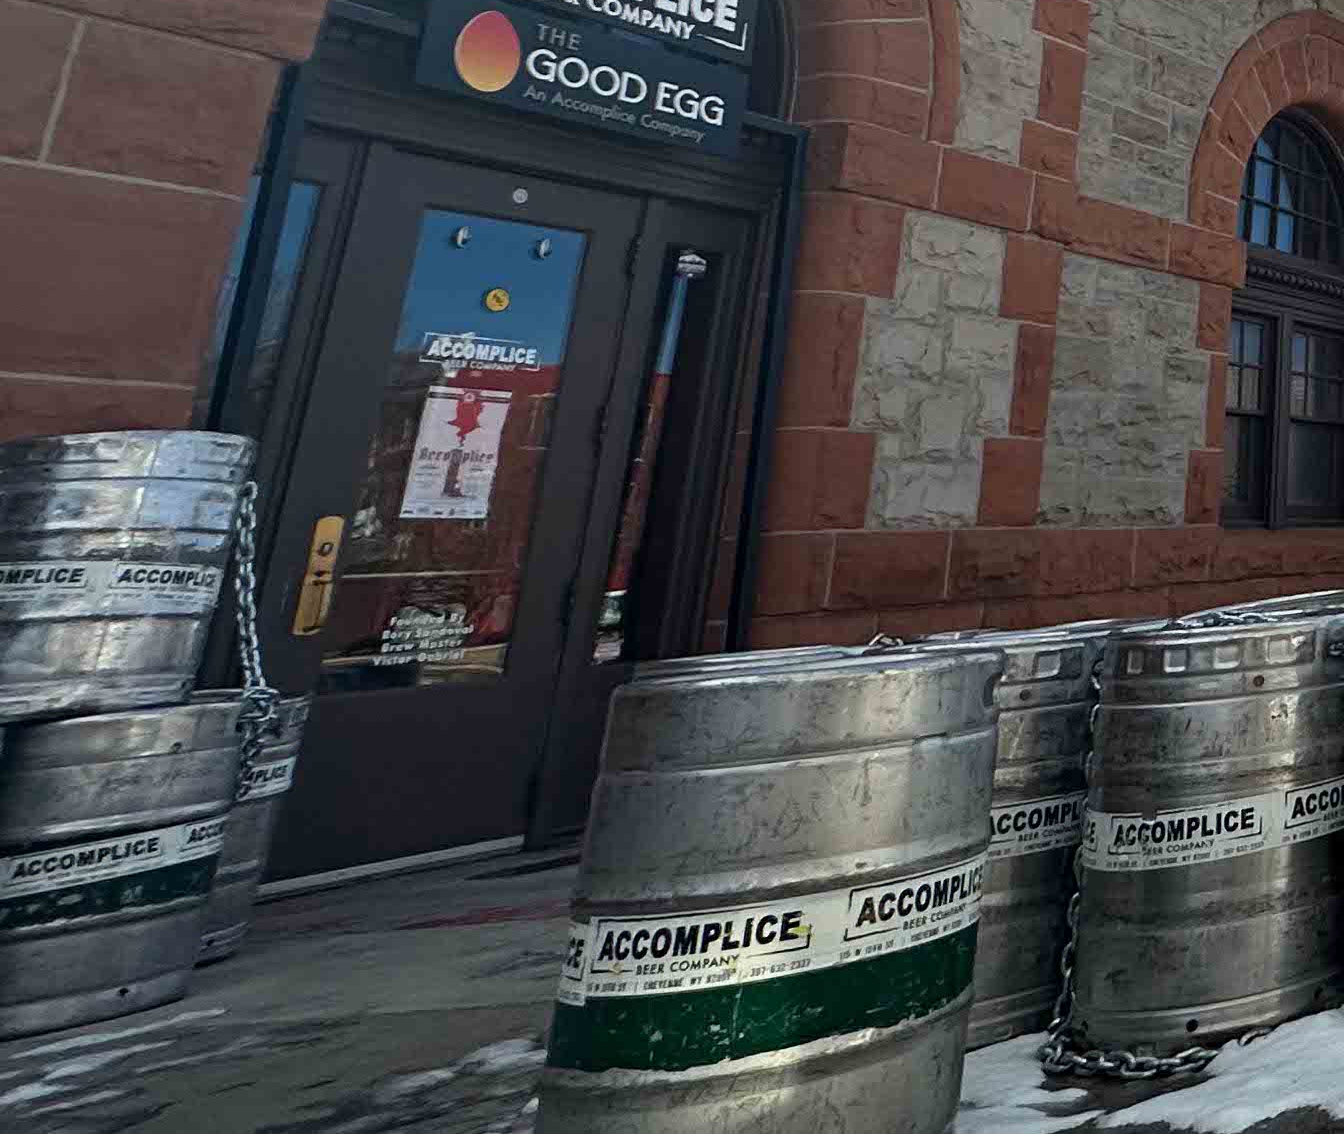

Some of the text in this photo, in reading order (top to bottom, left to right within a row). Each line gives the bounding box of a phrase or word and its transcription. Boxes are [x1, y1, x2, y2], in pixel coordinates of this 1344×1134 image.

[536, 23, 583, 52] THE
[525, 48, 725, 126] GOOD EGG
[523, 85, 706, 143] An Accomplice Company
[427, 339, 537, 364] ACCOMPLICE
[1113, 807, 1255, 847] ACCOMPLICE
[11, 836, 160, 879] ACCOMPLICE
[1166, 839, 1215, 853] COMPANY
[597, 910, 804, 962] ACCOMPLICE
[903, 916, 928, 932] BEER
[636, 954, 740, 976] BEER COMPANY
